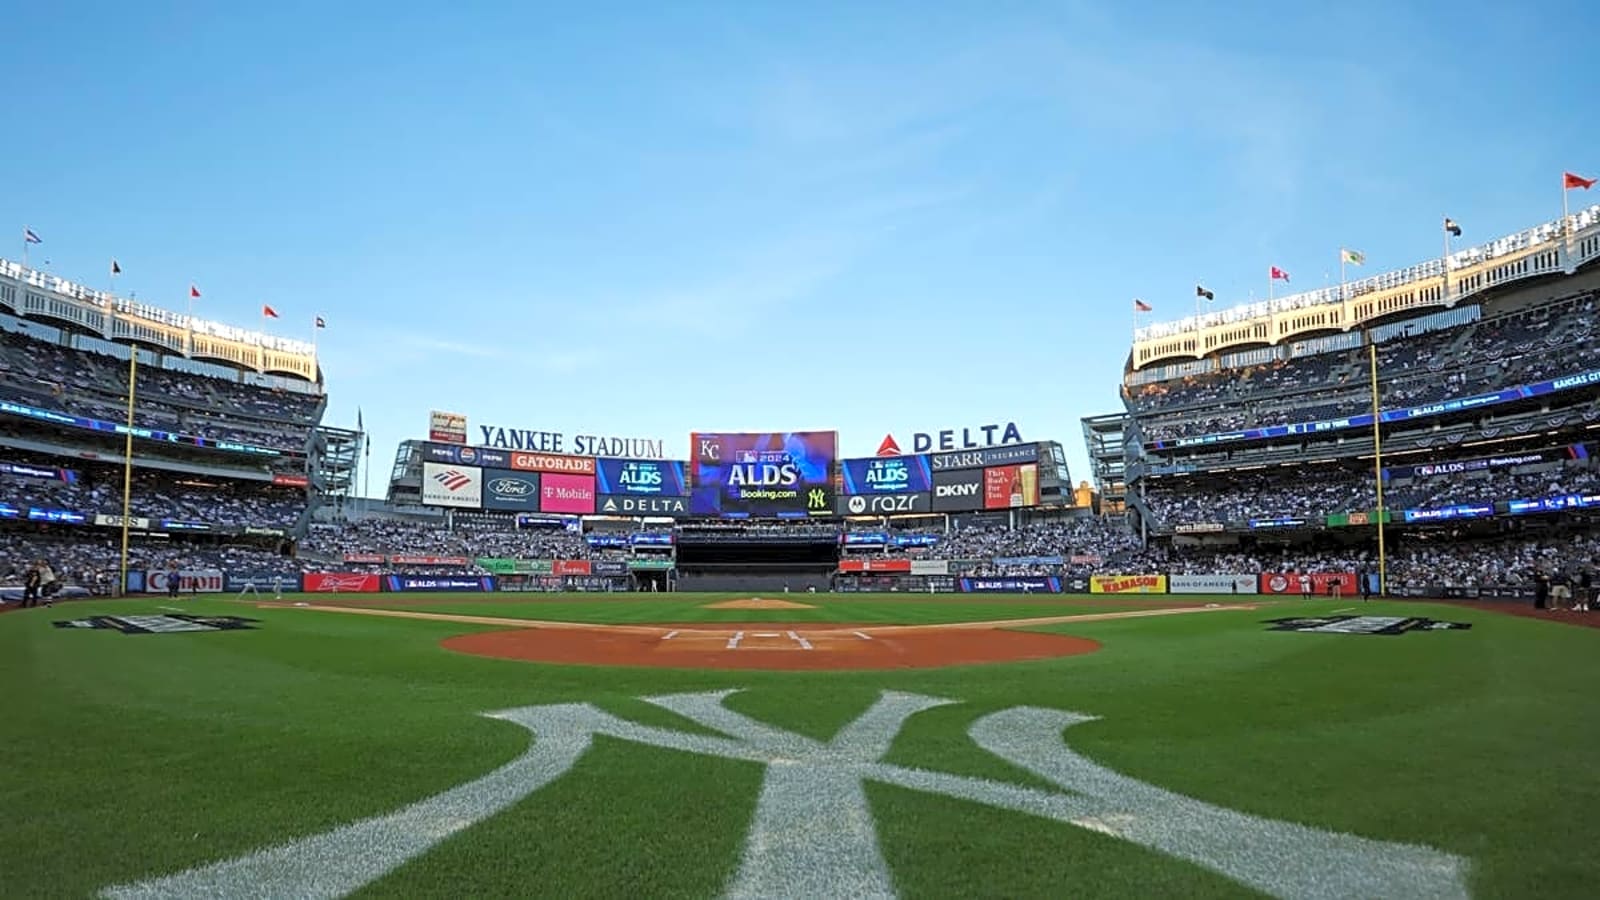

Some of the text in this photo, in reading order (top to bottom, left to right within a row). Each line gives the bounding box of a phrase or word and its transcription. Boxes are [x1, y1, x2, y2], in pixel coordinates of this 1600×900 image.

[480, 425, 563, 453] YANKEE
[574, 435, 664, 458] STADIUM
[914, 422, 1023, 453] DELTA
[701, 440, 719, 459] KC
[516, 456, 592, 471] GATORADE
[933, 449, 1036, 469] STARR INSURANCE
[728, 464, 797, 486] ALDS
[866, 468, 908, 482] ALDS
[1434, 463, 1465, 474] ALDS
[495, 478, 528, 495] Ford
[619, 471, 662, 485] ALDS
[740, 489, 797, 500] Booking.com
[808, 488, 826, 508] NY
[936, 483, 979, 497] DKNY
[623, 499, 684, 511] DELTA
[871, 495, 919, 512] razr
[148, 572, 221, 590] Cnon
